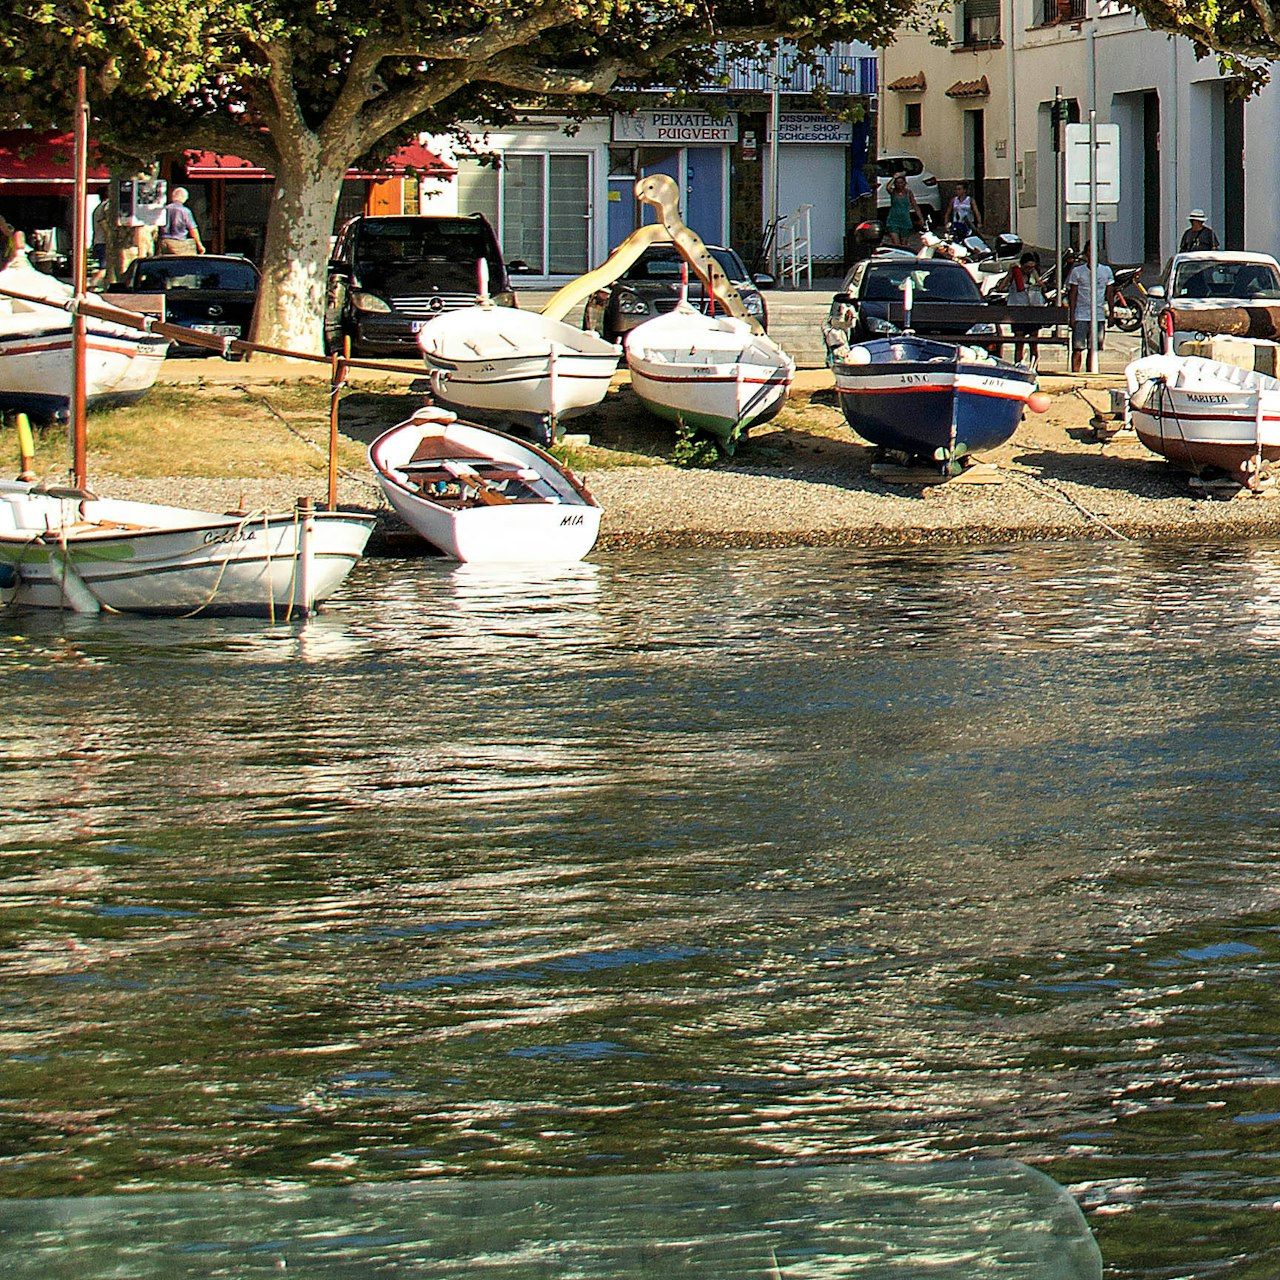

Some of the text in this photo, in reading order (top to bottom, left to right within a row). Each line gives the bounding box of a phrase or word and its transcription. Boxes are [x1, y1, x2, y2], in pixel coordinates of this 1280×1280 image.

[658, 128, 730, 139] PUIGVERT
[900, 374, 930, 383] JONC
[1186, 393, 1229, 403] MARIETA
[560, 514, 584, 526] MIA
